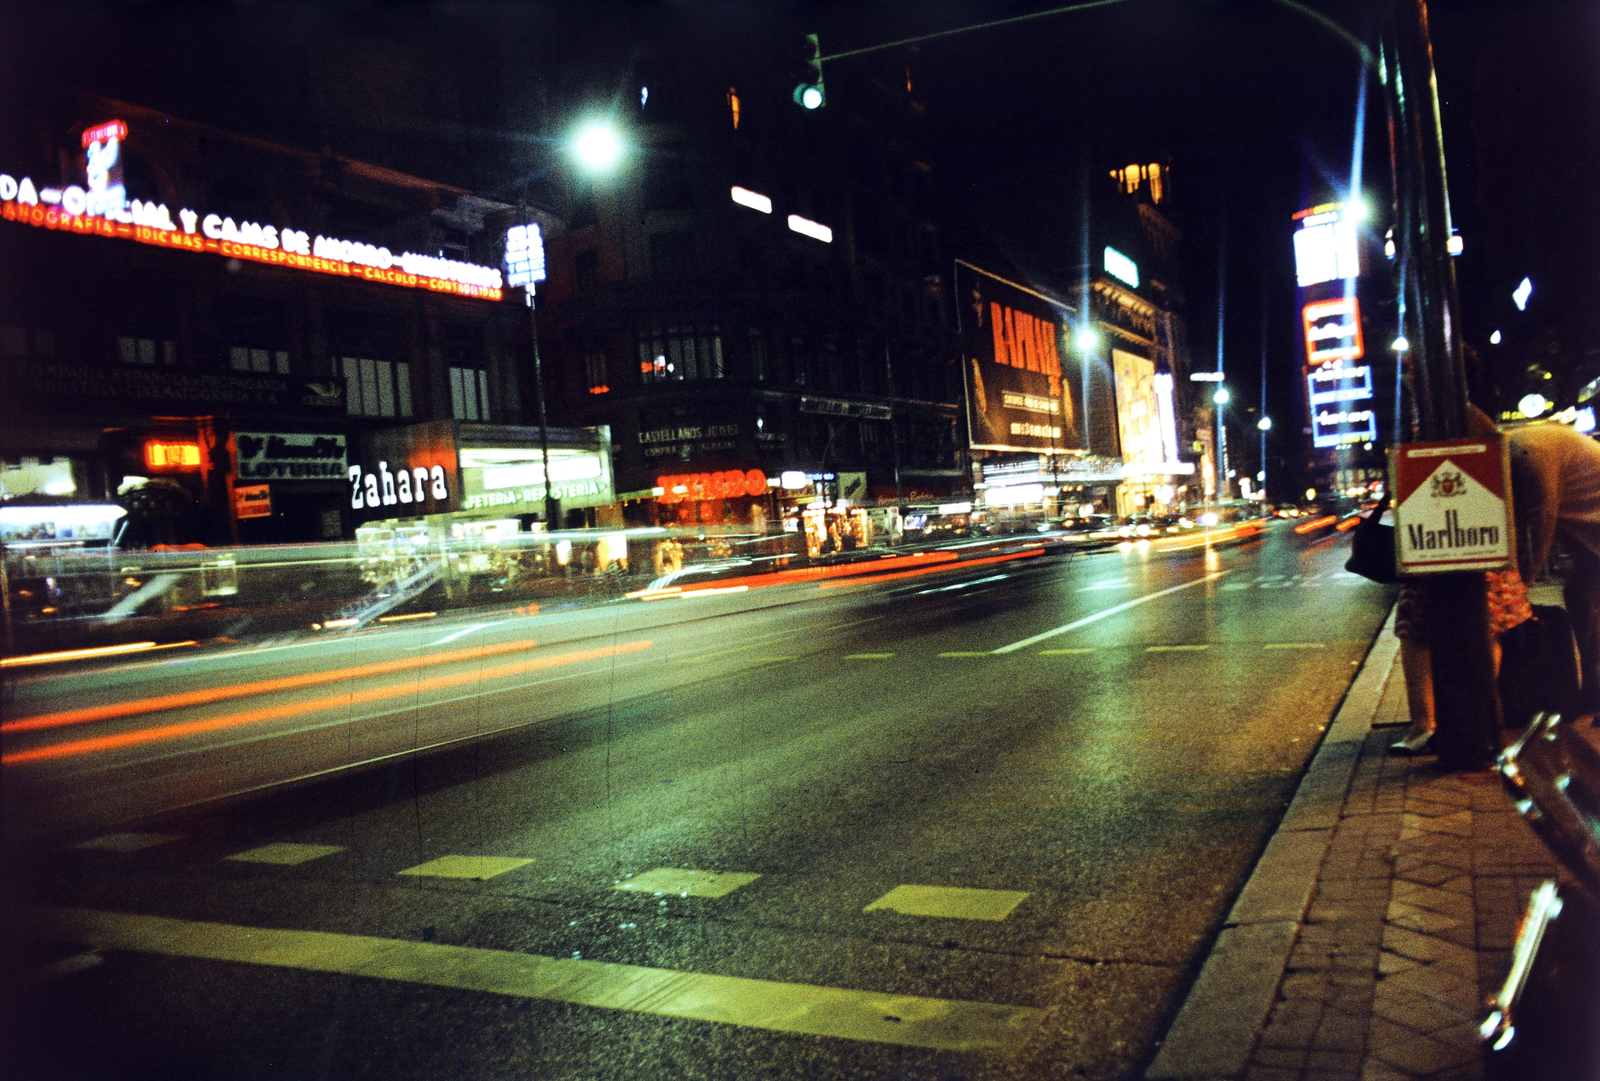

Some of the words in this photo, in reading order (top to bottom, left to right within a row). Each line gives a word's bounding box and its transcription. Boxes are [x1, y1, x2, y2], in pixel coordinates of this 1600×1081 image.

[180, 208, 198, 234] Y
[281, 228, 310, 256] DE
[221, 240, 350, 275] CORRESPONDENCIA
[364, 266, 418, 286] CALCULO
[429, 277, 503, 300] CONTABILIDAD
[349, 461, 448, 510] Zahara
[1408, 509, 1499, 550] Marlboro
